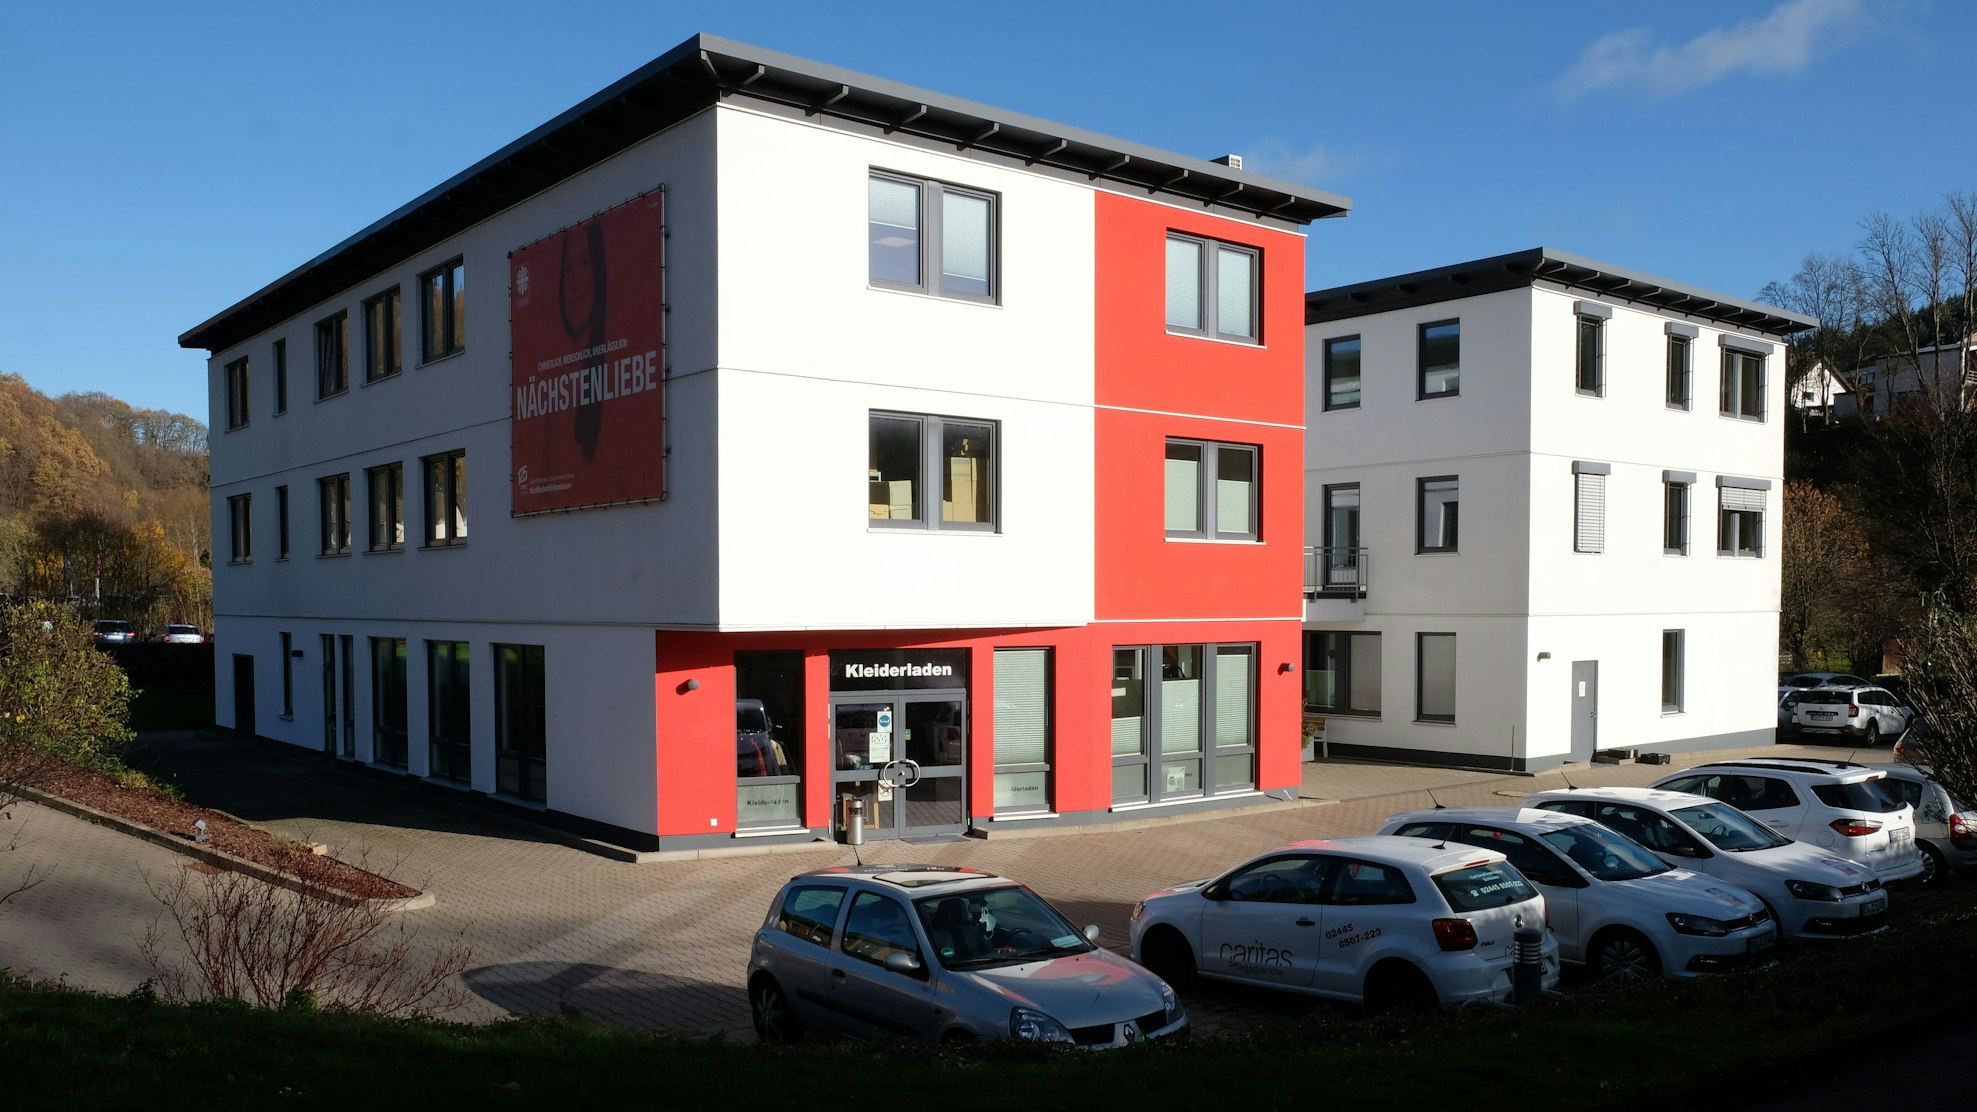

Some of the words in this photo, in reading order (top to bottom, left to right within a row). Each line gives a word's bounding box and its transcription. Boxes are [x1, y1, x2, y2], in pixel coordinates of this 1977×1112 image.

[517, 350, 657, 421] NÄCHSTENLIEBE
[845, 662, 953, 678] Kleiderladen
[1480, 883, 1501, 894] 02445
[1325, 923, 1354, 939] 02445
[1338, 928, 1382, 948] 8507-223
[1219, 938, 1293, 967] caritas
[1229, 960, 1283, 976] Pflegedienste
